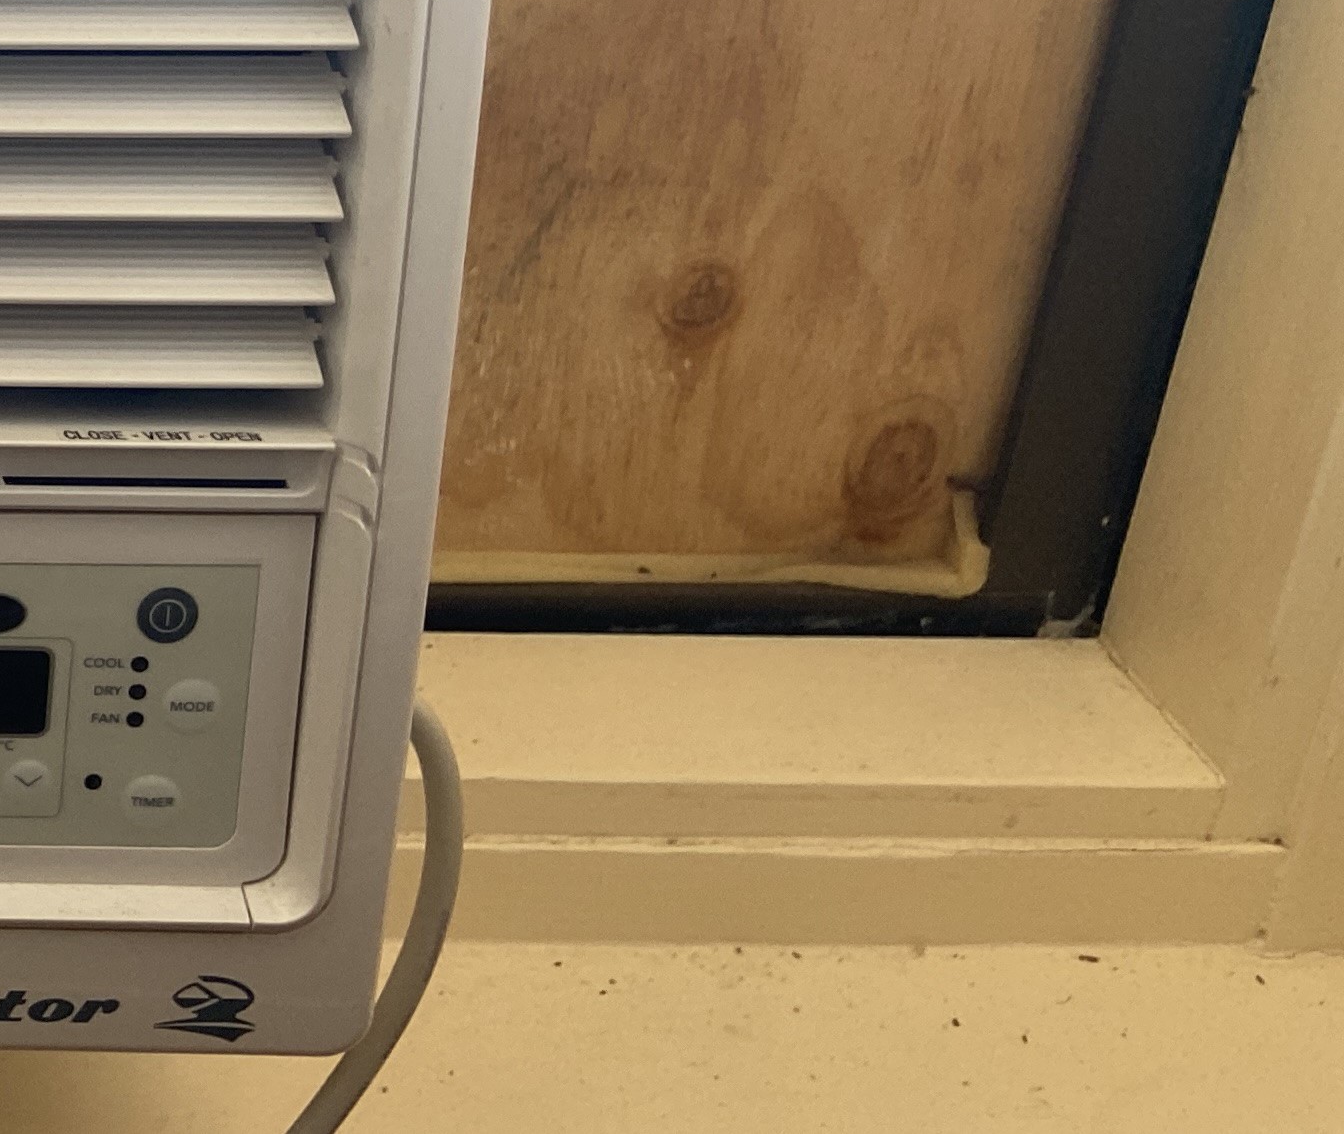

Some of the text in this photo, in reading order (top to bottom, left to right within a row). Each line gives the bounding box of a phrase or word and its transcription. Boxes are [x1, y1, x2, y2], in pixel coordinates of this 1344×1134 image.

[63, 430, 127, 441] CLOSE
[141, 431, 192, 442] VENT
[209, 431, 263, 442] OPEN
[83, 657, 125, 668] COOL
[93, 686, 123, 696] DRY
[169, 701, 215, 712] MODE
[90, 713, 121, 724] FAN
[131, 796, 174, 808] TIMER
